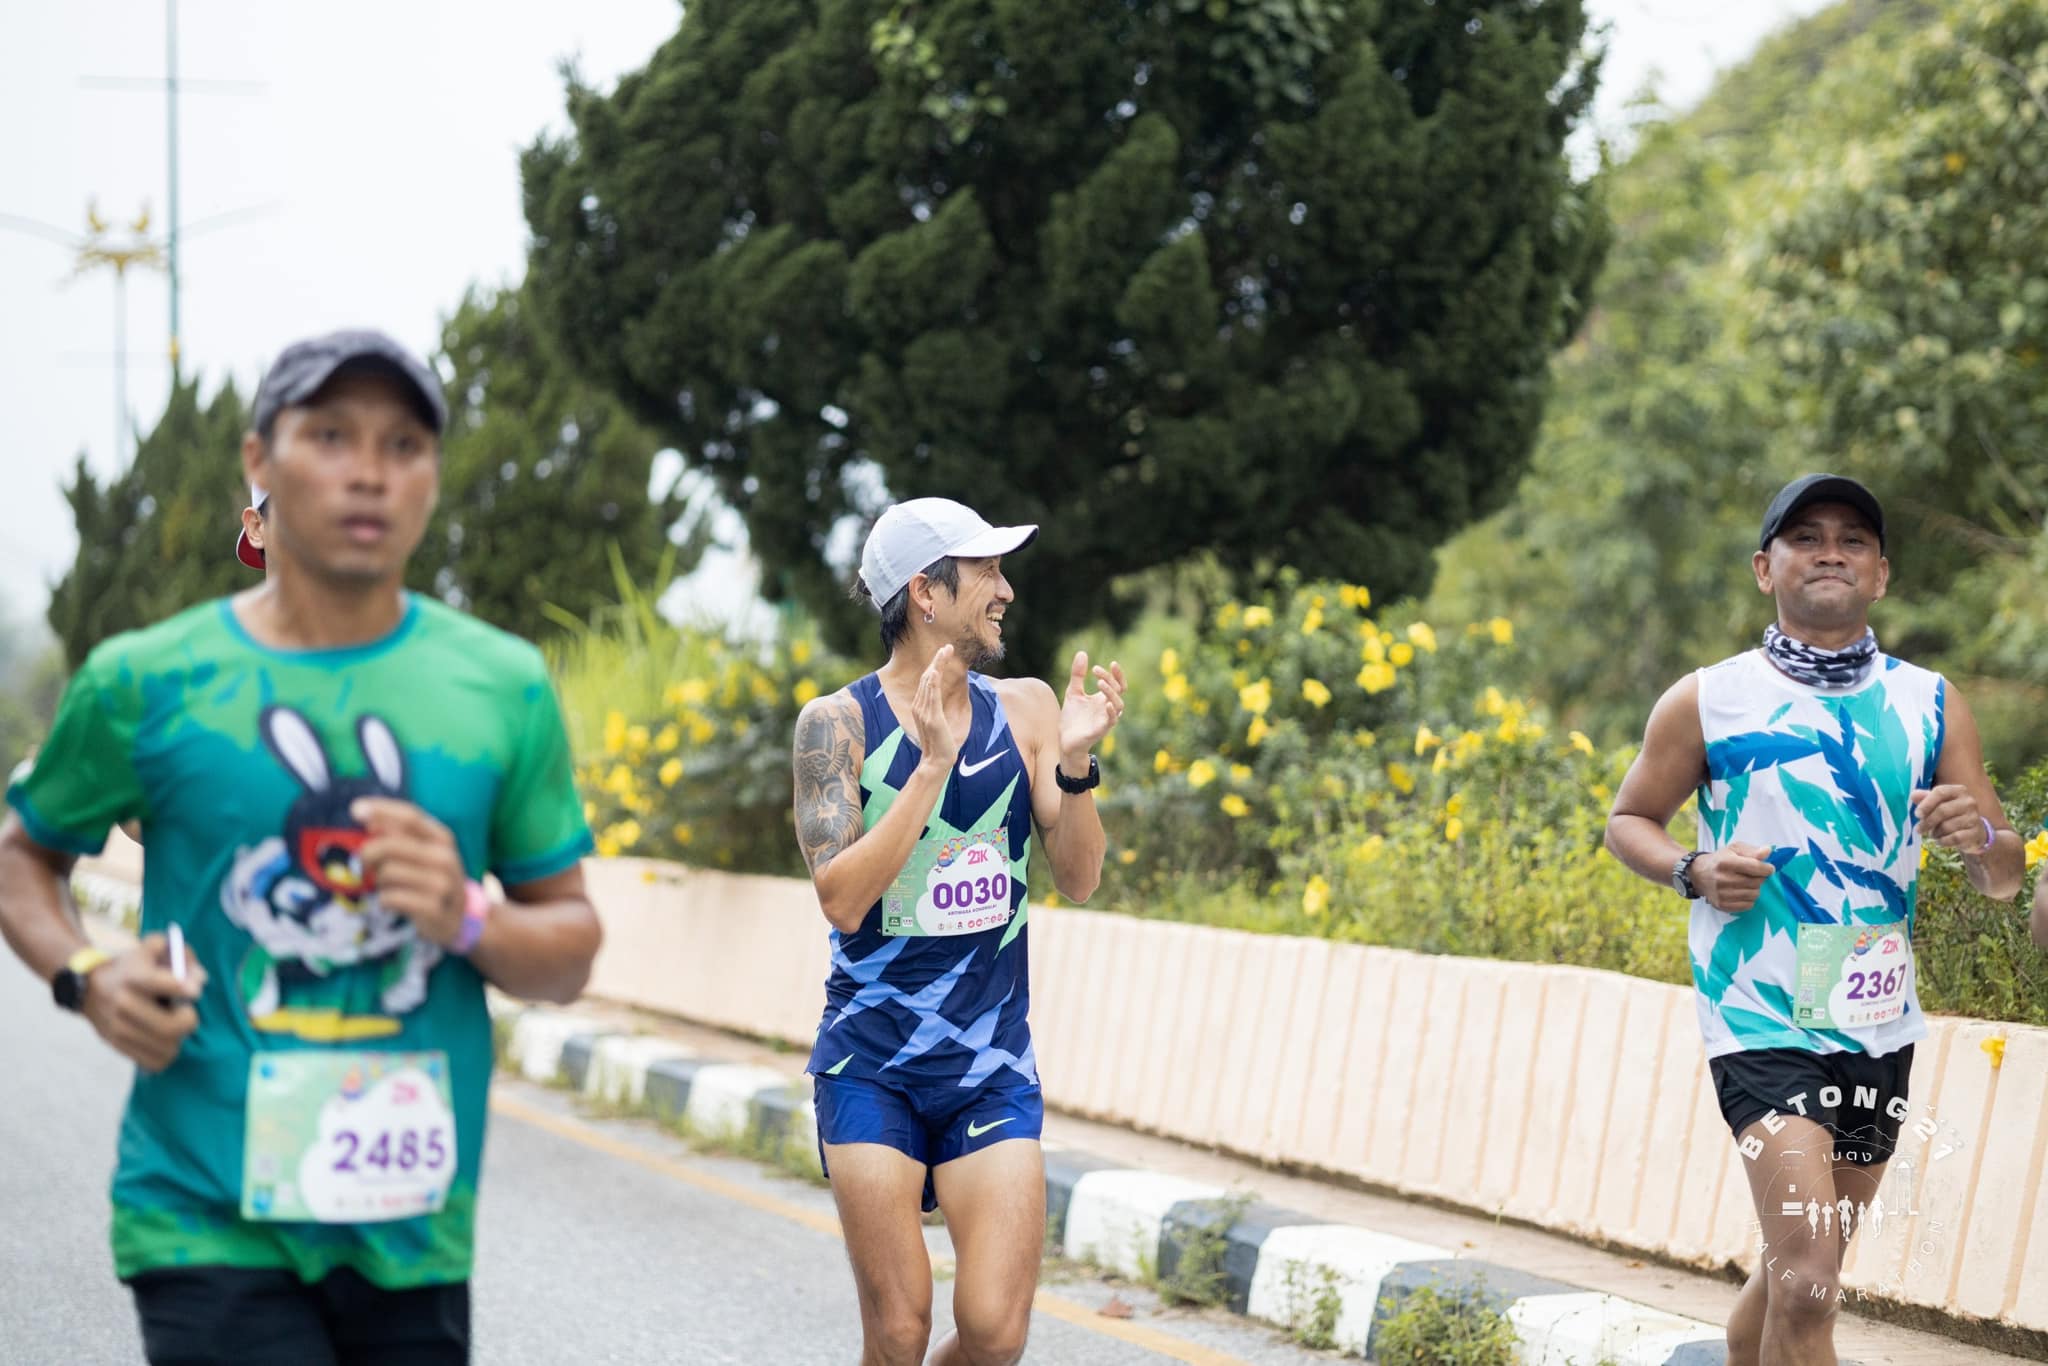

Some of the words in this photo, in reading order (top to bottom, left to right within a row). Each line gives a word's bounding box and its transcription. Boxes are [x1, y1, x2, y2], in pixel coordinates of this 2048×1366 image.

[968, 848, 988, 865] 21K
[933, 872, 1007, 909] 0030
[1847, 963, 1906, 1000] 2367
[333, 1128, 446, 1171] 2485
